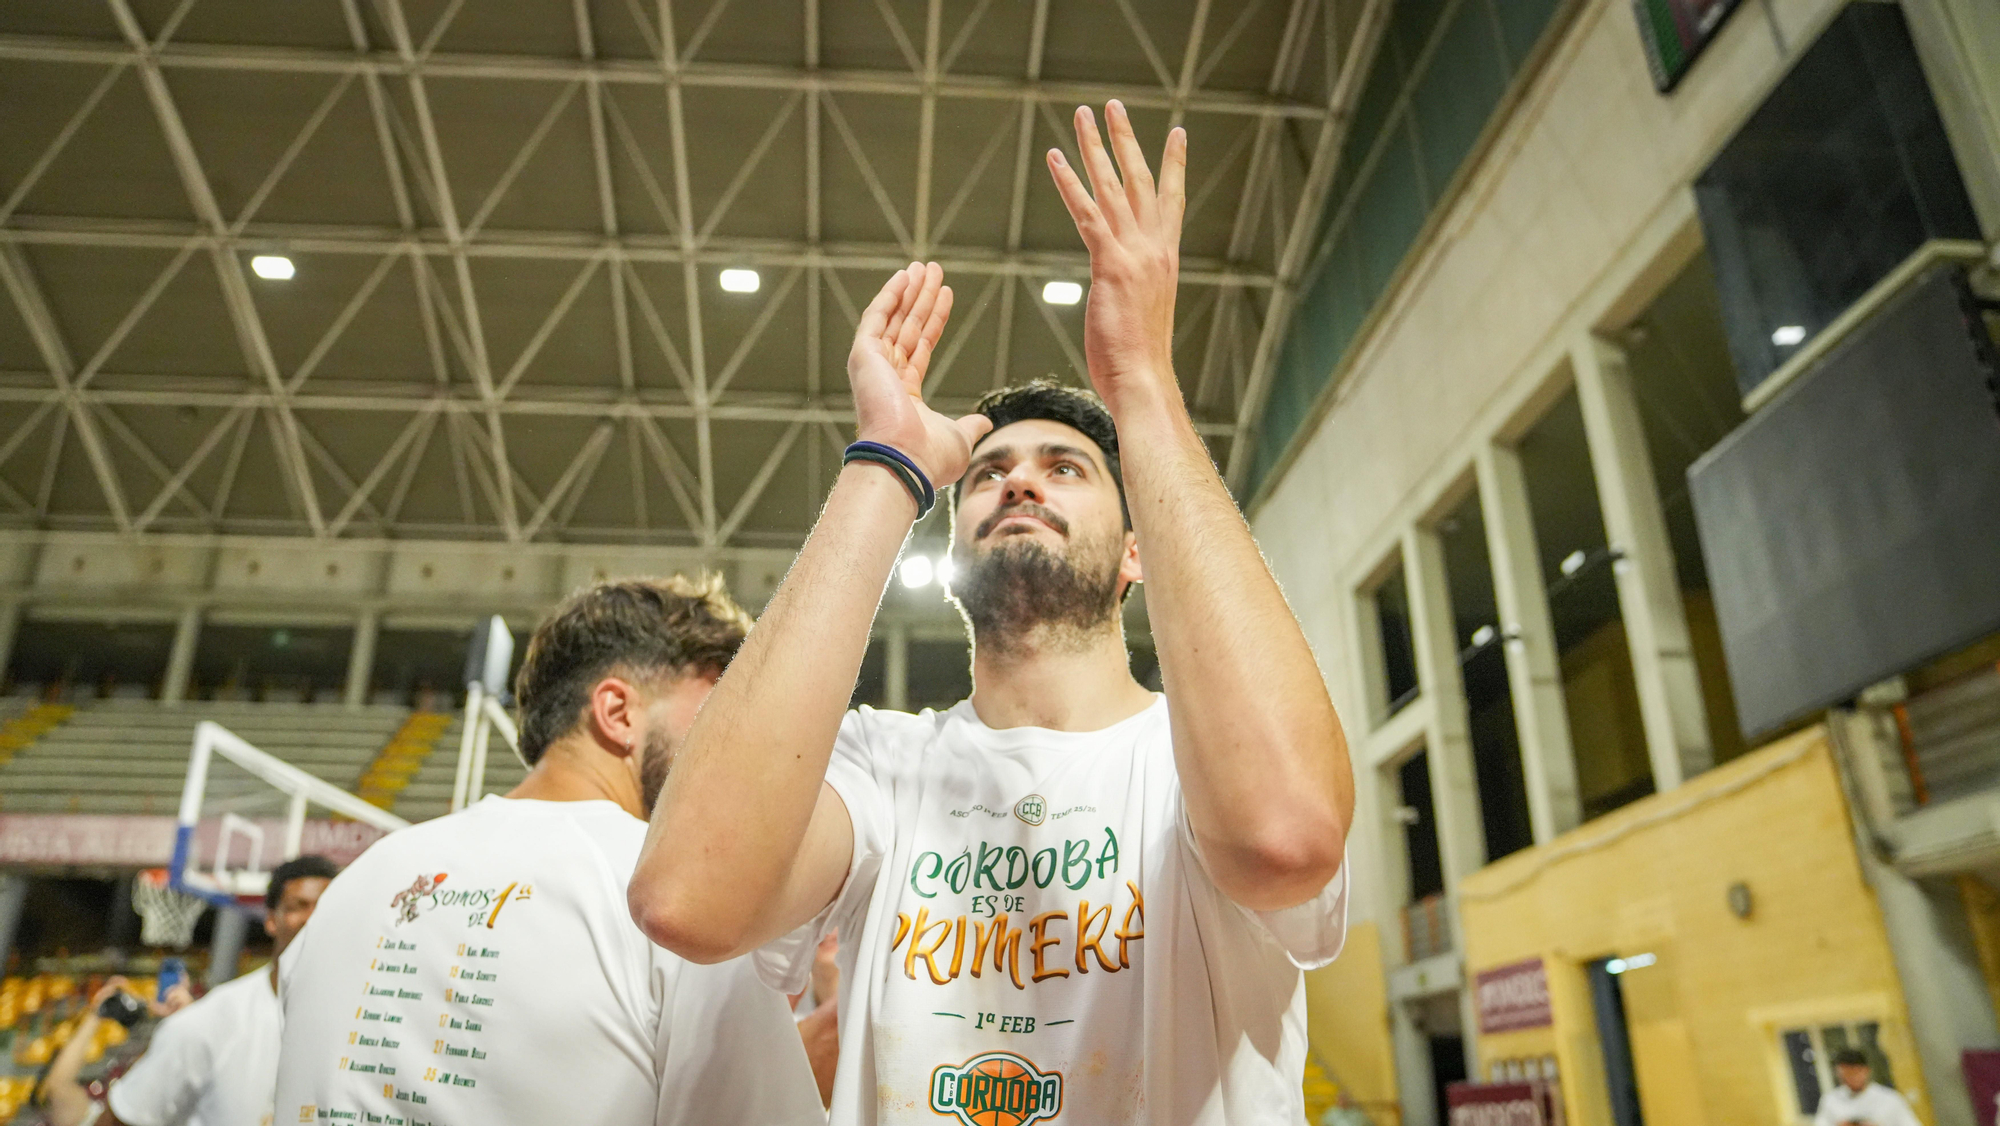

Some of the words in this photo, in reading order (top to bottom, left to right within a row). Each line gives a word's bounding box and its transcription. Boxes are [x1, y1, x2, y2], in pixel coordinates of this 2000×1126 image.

[1022, 803, 1042, 817] CCB
[911, 826, 1119, 899] CÓRDOBA
[427, 888, 495, 911] SOMOS
[971, 895, 998, 918] ES
[1004, 894, 1025, 913] DE
[468, 911, 487, 928] DE
[439, 1013, 448, 1028] 17
[975, 1012, 995, 1029] 1ª
[999, 1016, 1036, 1034] FEB
[433, 1039, 444, 1054] 27
[423, 1066, 438, 1082] 35
